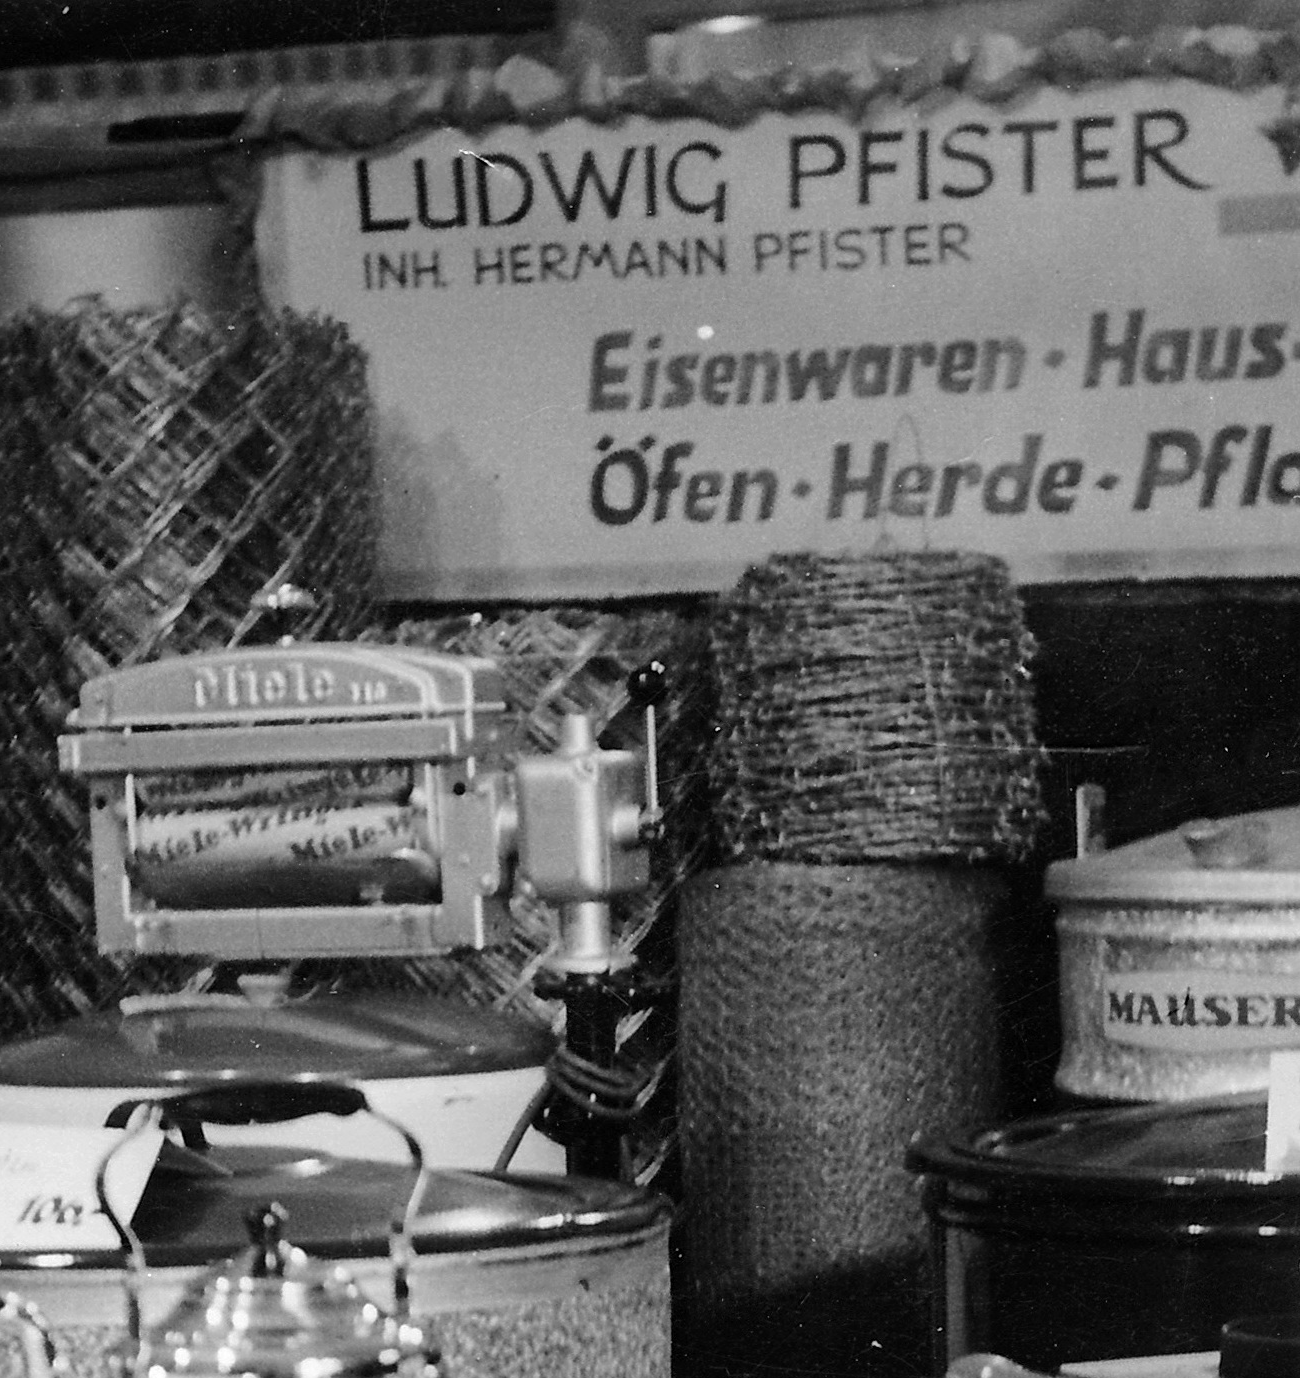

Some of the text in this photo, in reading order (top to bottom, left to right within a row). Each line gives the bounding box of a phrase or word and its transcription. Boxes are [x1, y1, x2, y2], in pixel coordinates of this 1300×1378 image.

[356, 108, 1214, 233] LUDWIG PFISTER
[363, 222, 971, 290] INH. HERMANN PFISTER
[587, 331, 1027, 413] Eisenwaren
[589, 433, 779, 526] Öfen
[826, 432, 1083, 522] Herde
[194, 660, 333, 708] Miele
